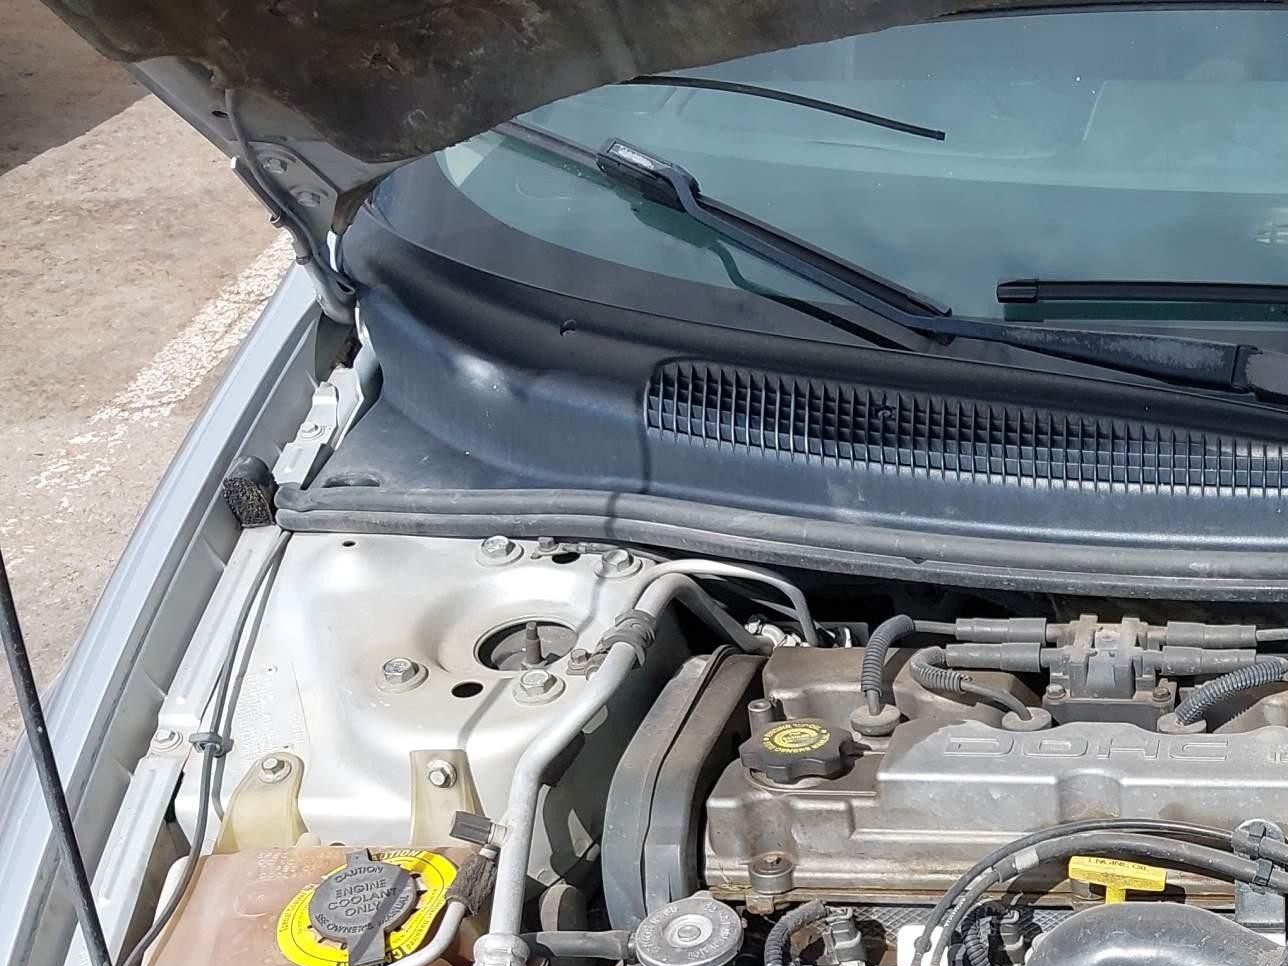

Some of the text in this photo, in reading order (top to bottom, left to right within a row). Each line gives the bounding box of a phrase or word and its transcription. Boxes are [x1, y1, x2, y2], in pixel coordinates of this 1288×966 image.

[945, 736, 1228, 762] DOHC
[335, 866, 383, 883] CAUTION
[336, 879, 387, 898] ENGINE
[328, 888, 396, 910] COOLANT
[345, 901, 381, 916] ONLY
